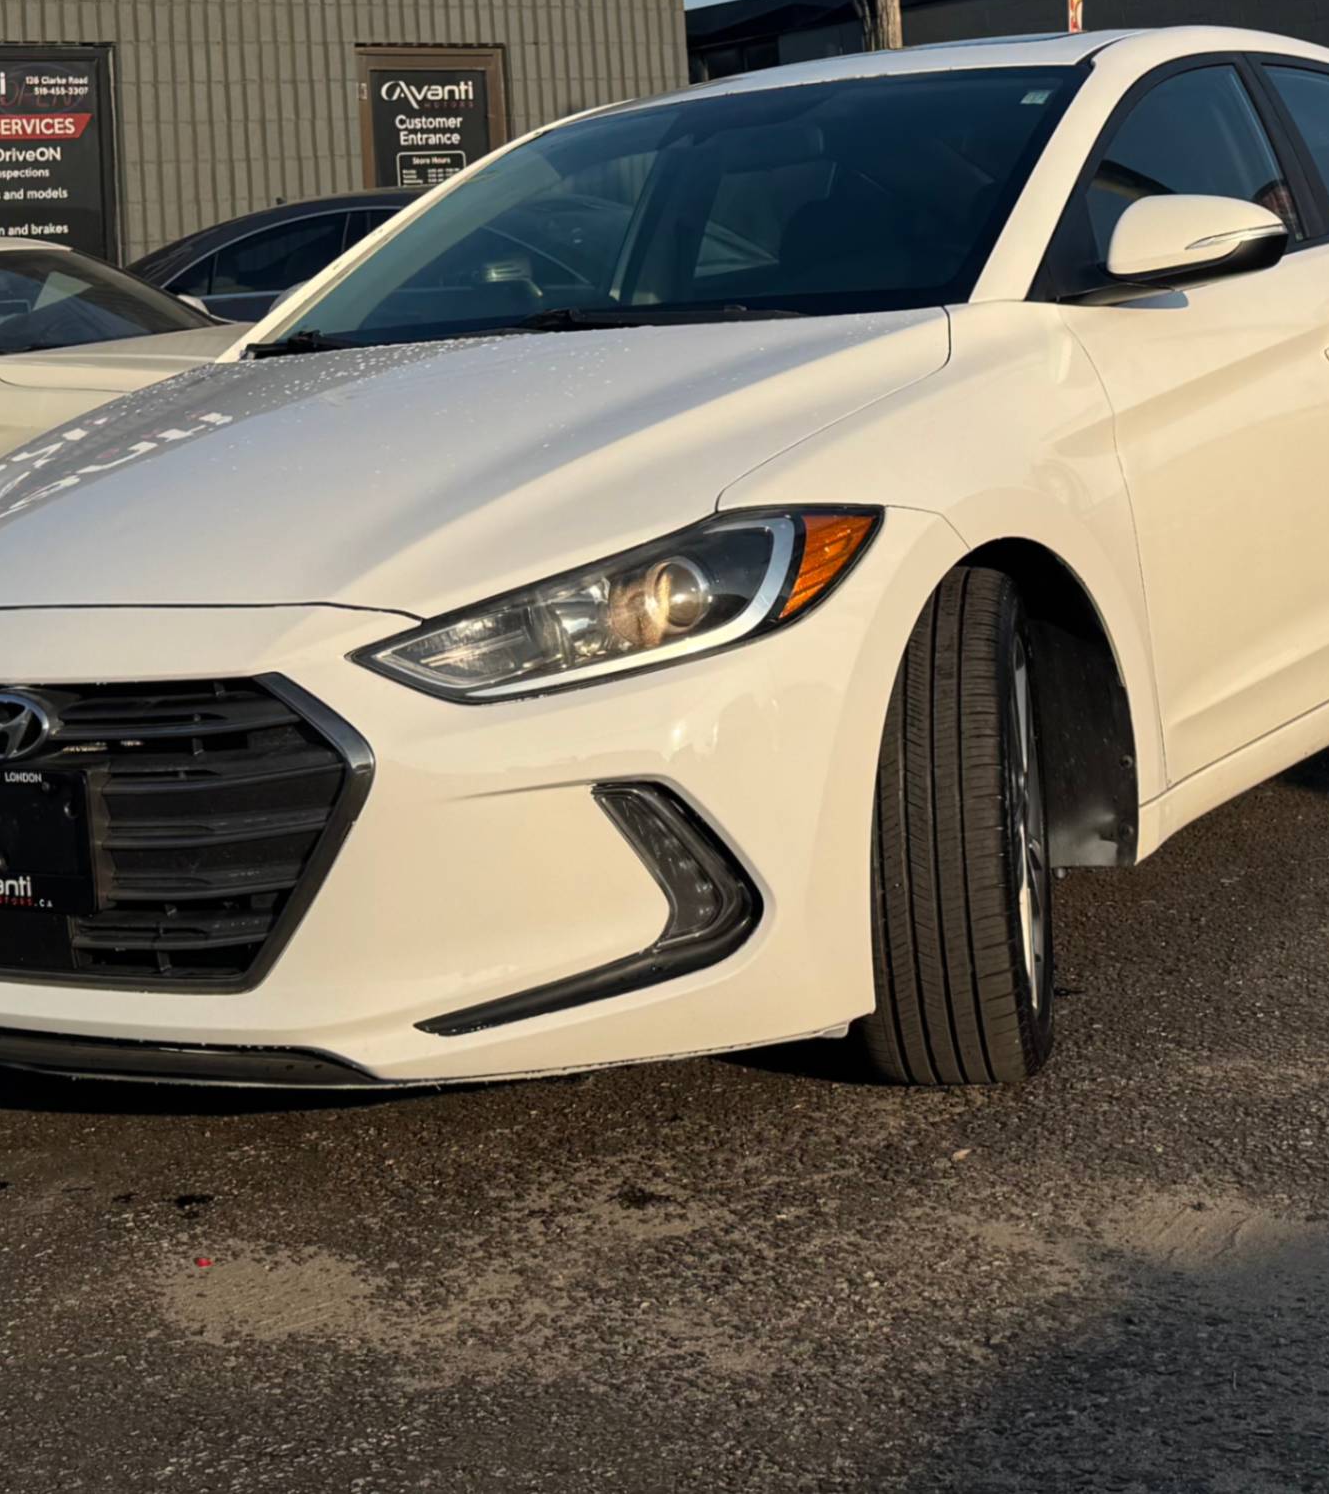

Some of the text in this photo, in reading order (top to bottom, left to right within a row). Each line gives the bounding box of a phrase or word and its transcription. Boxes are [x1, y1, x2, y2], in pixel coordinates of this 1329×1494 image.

[380, 80, 474, 109] Avanti
[395, 114, 463, 130] Customer
[399, 131, 461, 146] Entrance
[3, 188, 24, 201] and
[27, 187, 68, 200] models
[8, 224, 28, 236] and
[31, 222, 69, 236] brakes
[4, 772, 42, 783] LONDON
